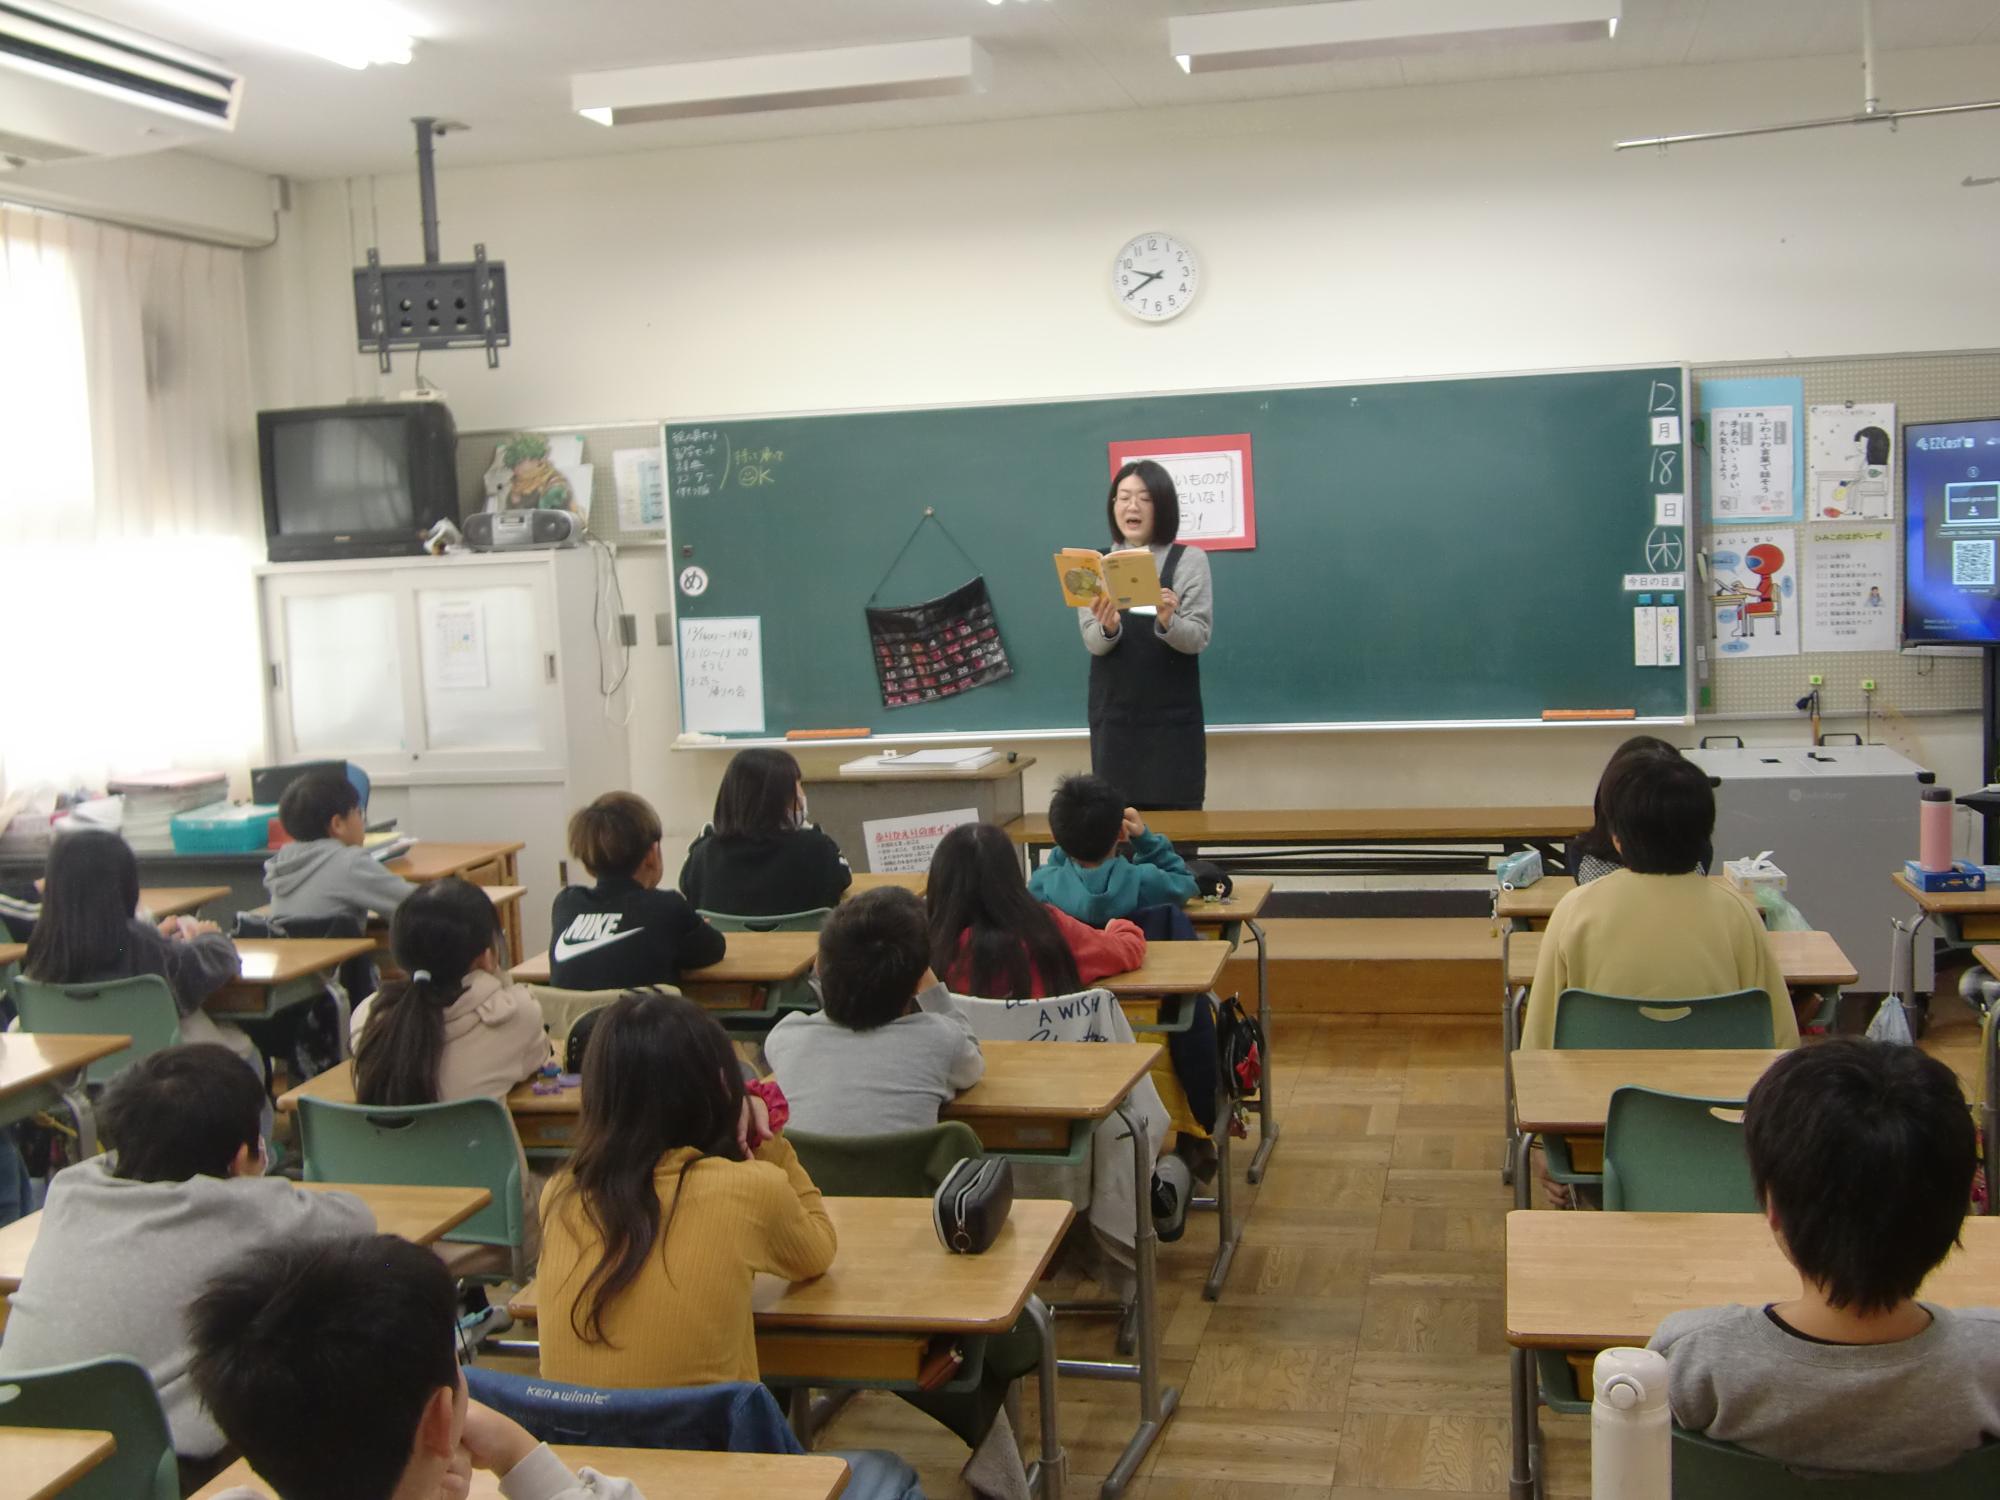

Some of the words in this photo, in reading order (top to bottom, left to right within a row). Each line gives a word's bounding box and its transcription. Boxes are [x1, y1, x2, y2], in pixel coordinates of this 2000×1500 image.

[1134, 245, 1143, 257] 11
[1147, 239, 1158, 251] 12
[1165, 241, 1170, 253] 1
[1176, 250, 1184, 263] 2
[1123, 257, 1134, 270] 10
[1182, 265, 1190, 277] 3
[1121, 274, 1129, 286] 9
[1178, 282, 1187, 294] 4
[1140, 298, 1148, 310] 7
[1154, 301, 1163, 312] 6
[1168, 294, 1176, 306] 5
[1648, 380, 1676, 412] 12
[1658, 422, 1670, 438] 月
[1929, 436, 1962, 450] EZCast
[1760, 419, 1771, 494] ふわふわ言葉で話そう
[1650, 448, 1677, 485] 18
[1664, 503, 1676, 517] 日
[684, 571, 703, 590] め
[563, 912, 624, 941] NIKE
[1039, 1009, 1052, 1027] A
[1058, 996, 1100, 1021] WISH
